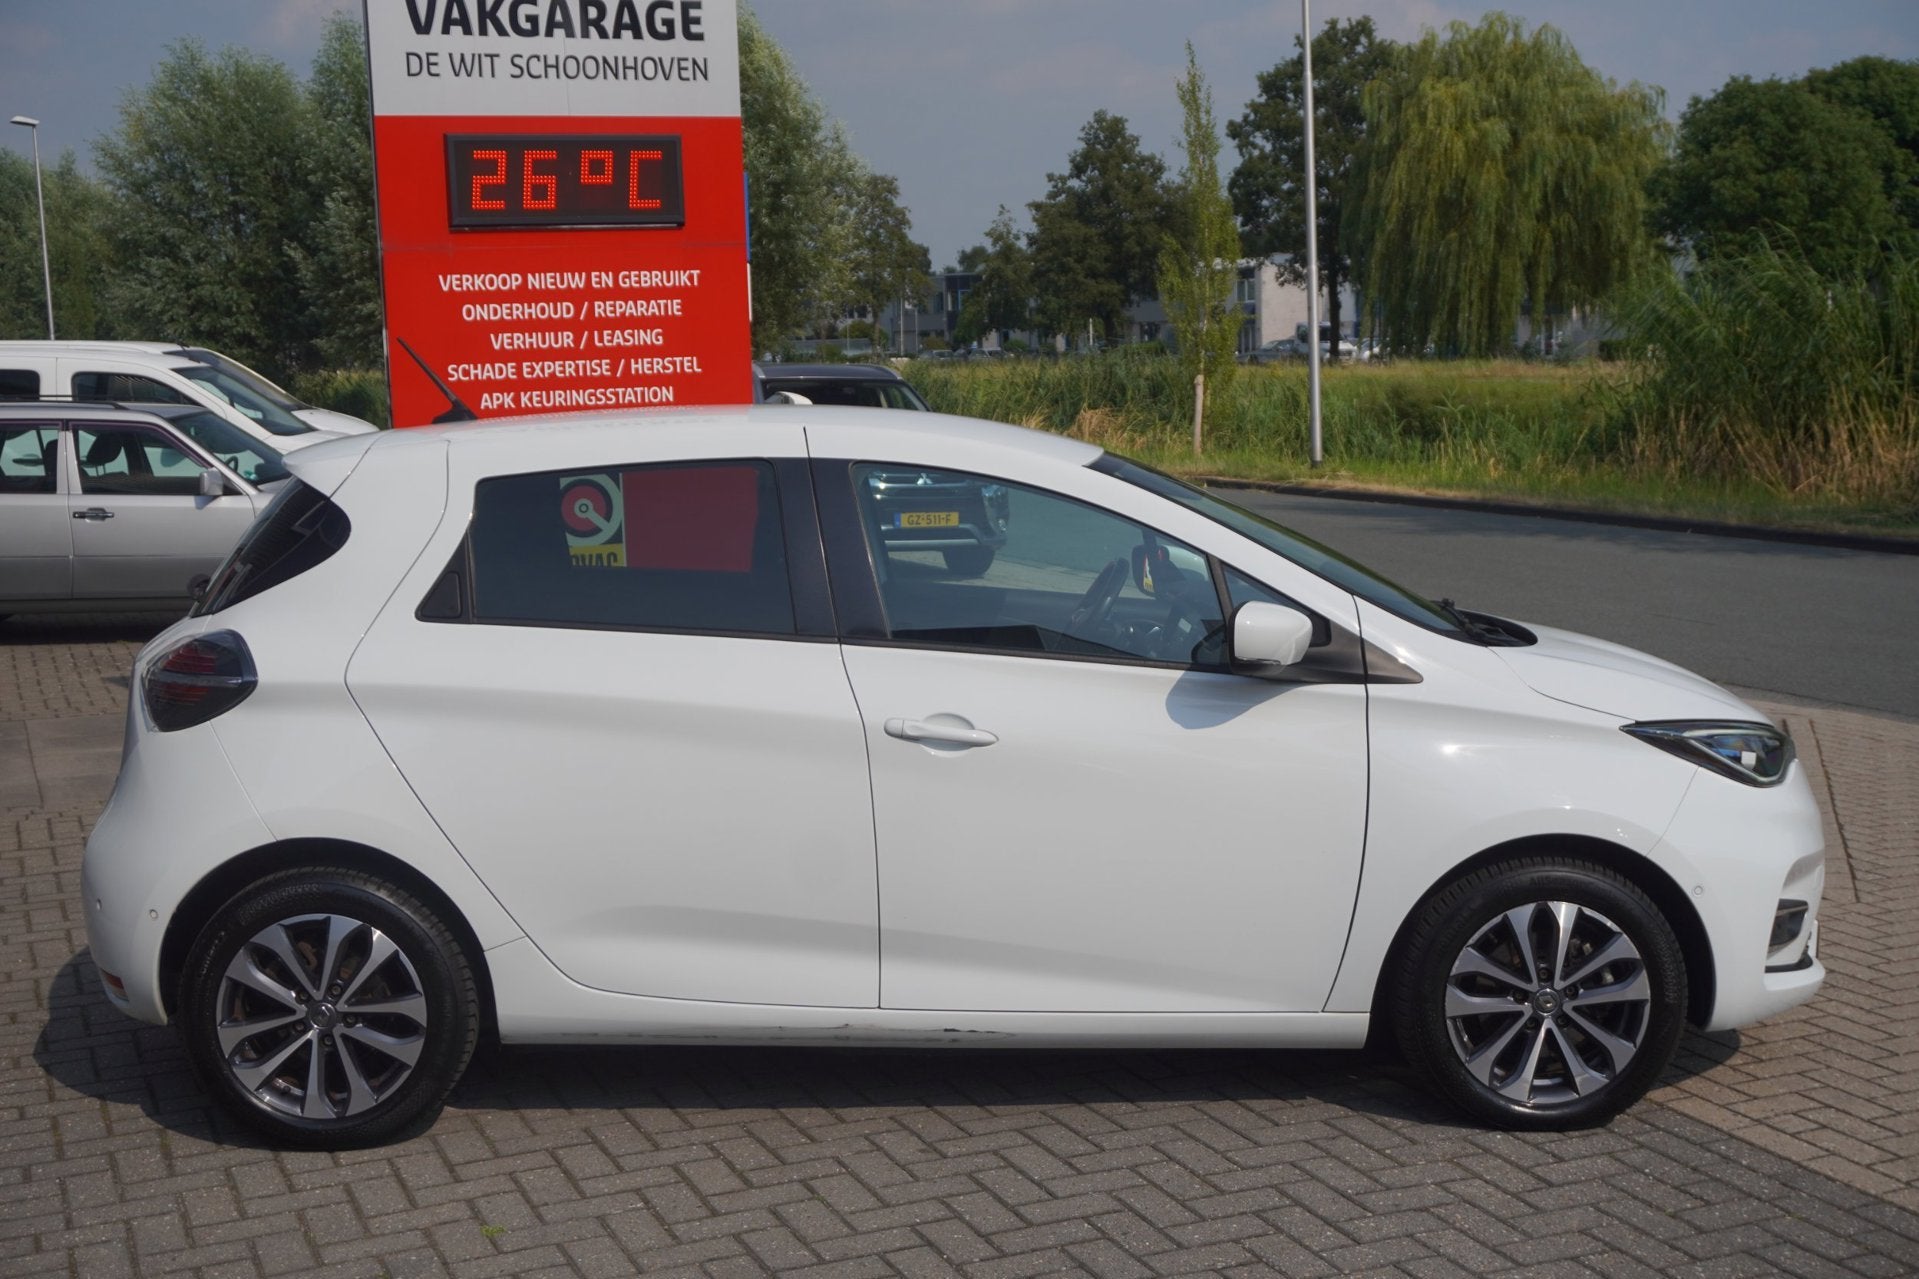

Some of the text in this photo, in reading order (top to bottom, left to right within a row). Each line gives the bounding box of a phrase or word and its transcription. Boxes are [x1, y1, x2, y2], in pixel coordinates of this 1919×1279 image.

[405, 0, 705, 42] VAKGARAGE
[406, 52, 709, 82] DE WIT SCHOONHOVEN
[439, 270, 701, 292] VERKOOP NIEUW EN GEBRUIKT
[462, 302, 575, 321] ONDERHOUD
[594, 299, 683, 318] REPARATIE
[490, 331, 575, 350] VERHUUR
[594, 329, 664, 347] LEASING
[448, 362, 518, 381] SCHADE
[522, 359, 612, 379] EXPERTISE
[631, 356, 703, 375] HERSTEL
[480, 386, 675, 410] APK KEURINGSSTATION
[906, 513, 952, 526] GZ-511-F
